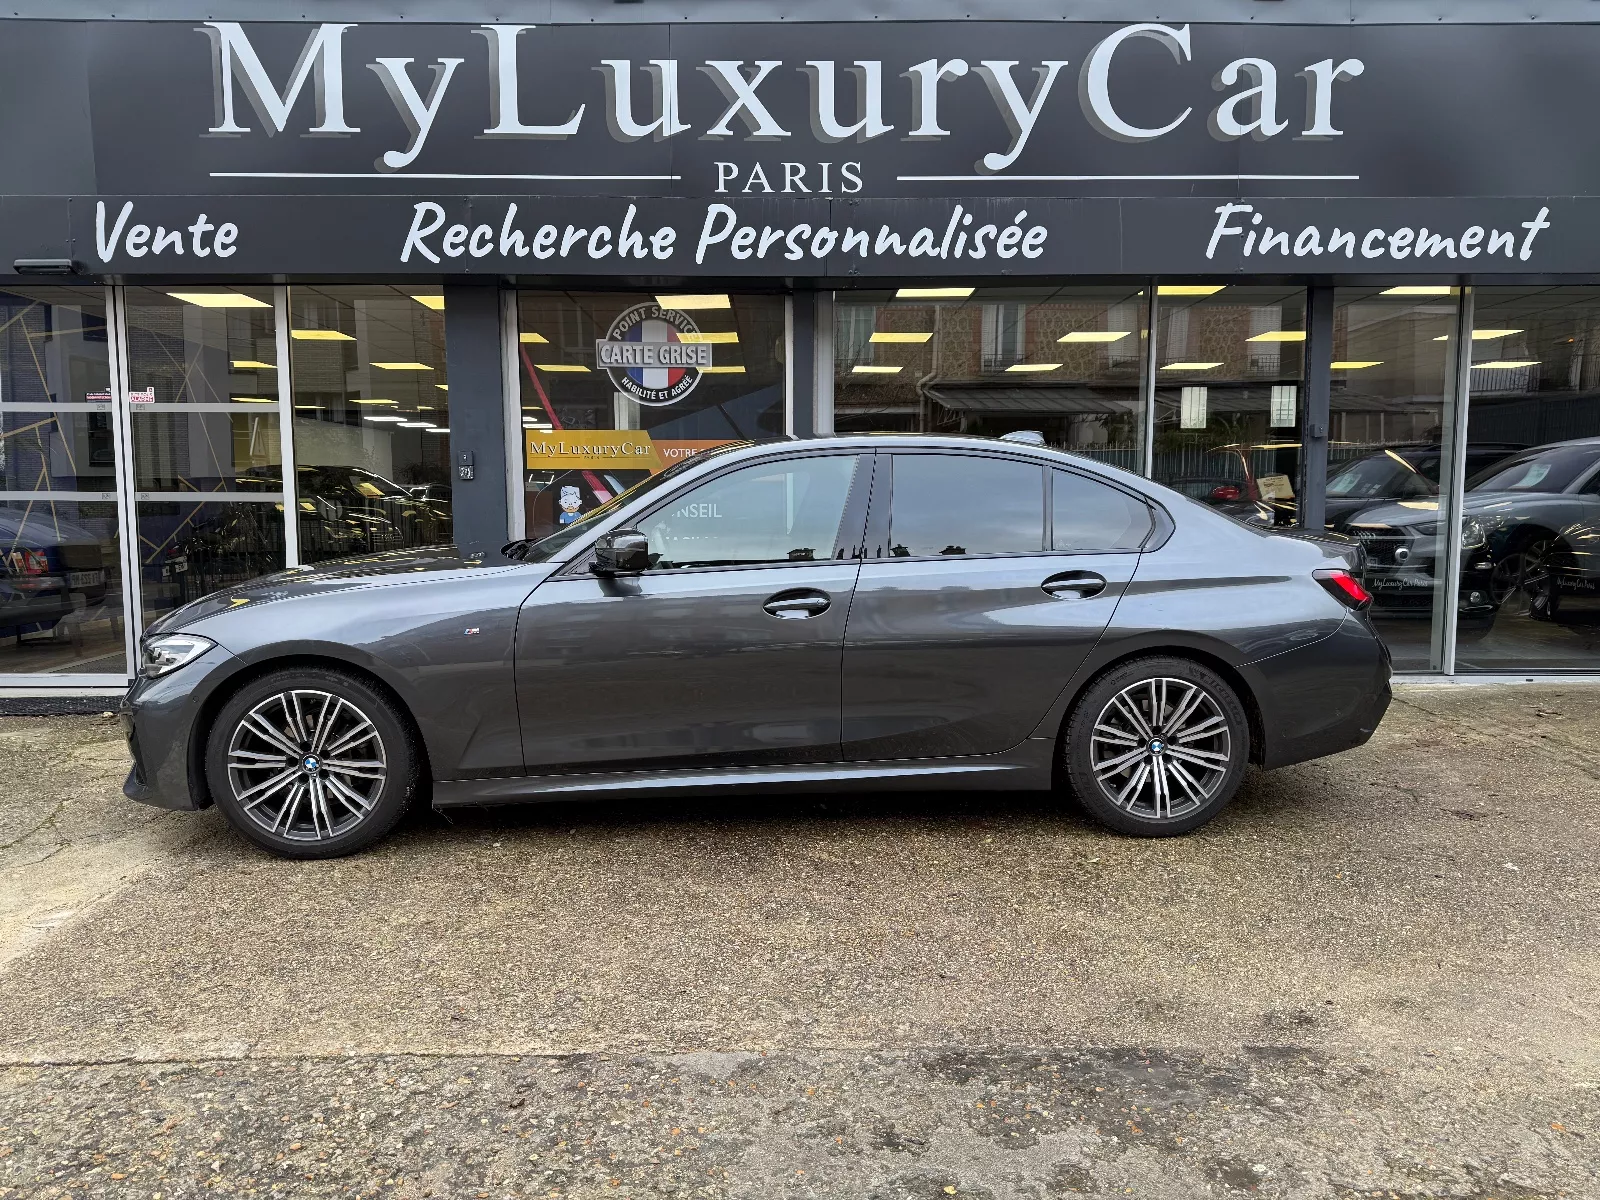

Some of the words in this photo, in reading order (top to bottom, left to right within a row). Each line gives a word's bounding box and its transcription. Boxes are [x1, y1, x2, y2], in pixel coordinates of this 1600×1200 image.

[202, 22, 1365, 170] MyLuxuryCar
[713, 161, 863, 193] PARIS
[95, 201, 240, 263] Vente
[400, 201, 677, 264] Recherche
[695, 203, 1049, 265] Personnalisée
[1205, 202, 1551, 262] Financement
[612, 307, 646, 340] POINT
[651, 306, 700, 342] SERVICE
[600, 344, 654, 365] CARTE
[659, 345, 708, 365] GRISE
[621, 376, 657, 400] HABILITÉ
[658, 390, 669, 400] ET
[529, 441, 651, 458] MyLuxuryCar
[663, 448, 698, 458] VOTRE
[671, 503, 723, 518] NSEIL
